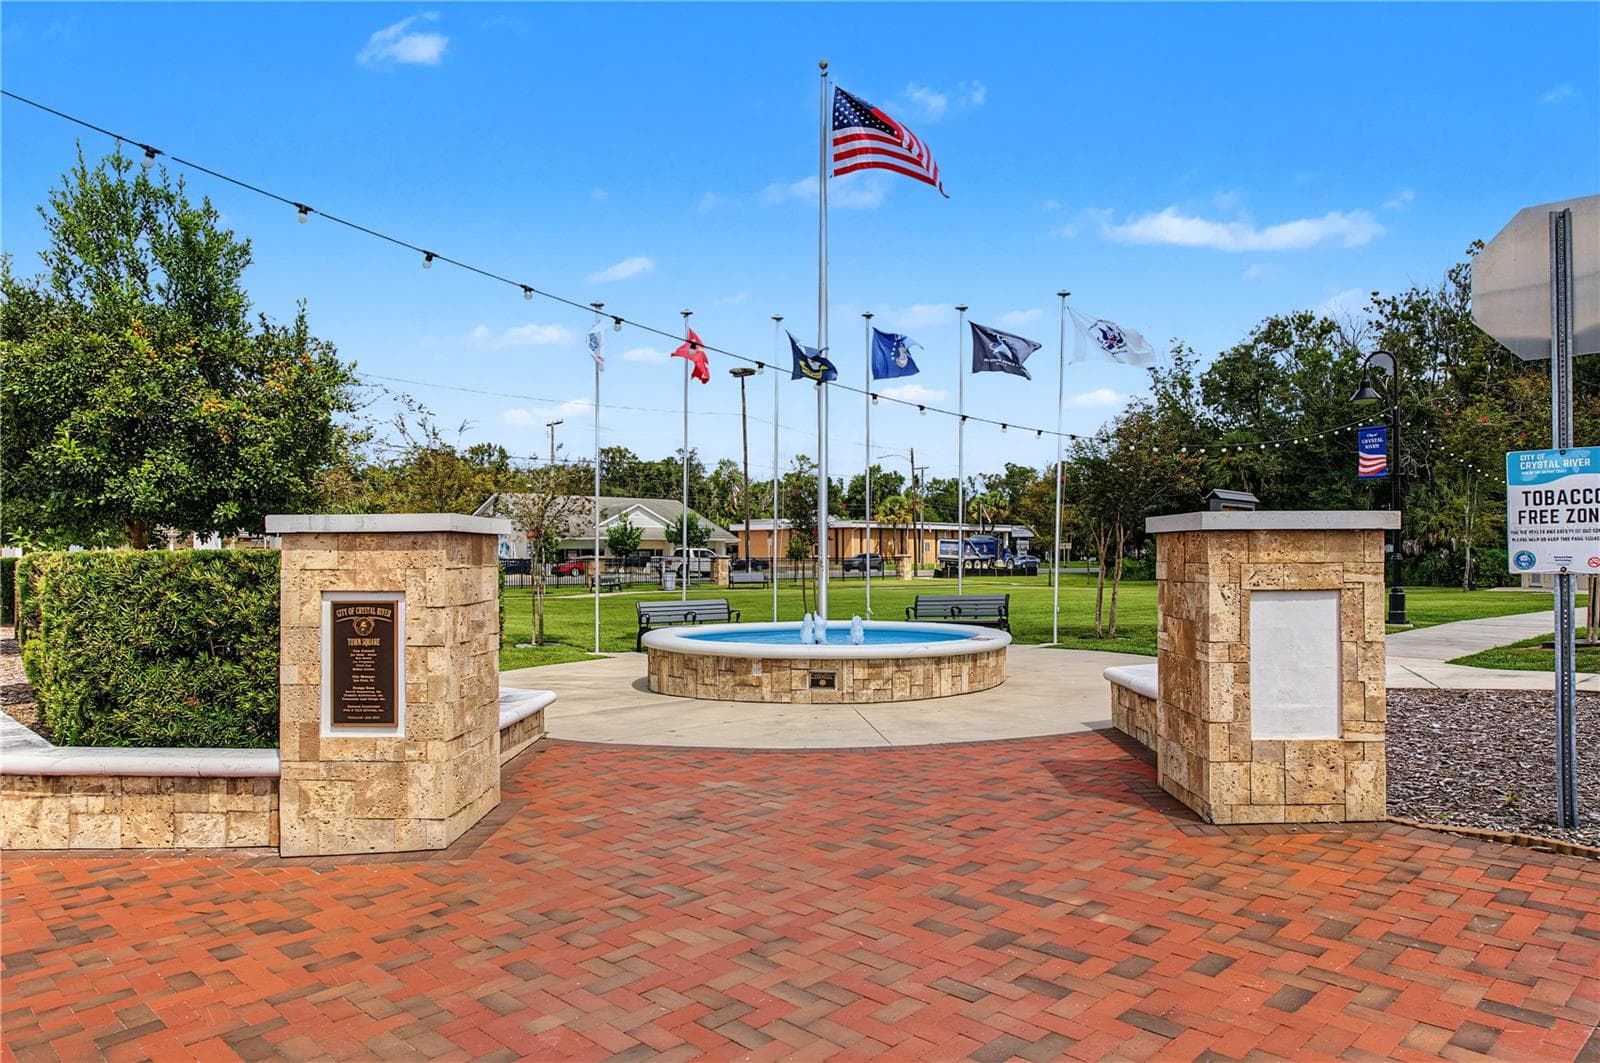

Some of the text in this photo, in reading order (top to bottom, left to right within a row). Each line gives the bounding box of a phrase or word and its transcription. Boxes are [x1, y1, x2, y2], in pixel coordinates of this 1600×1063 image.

[1520, 458, 1591, 470] CRYSTAL RIVER
[1518, 508, 1599, 524] FREE ZON
[336, 606, 392, 617] CITY OF CRYSTAL RIVER
[362, 638, 380, 647] SQUARE
